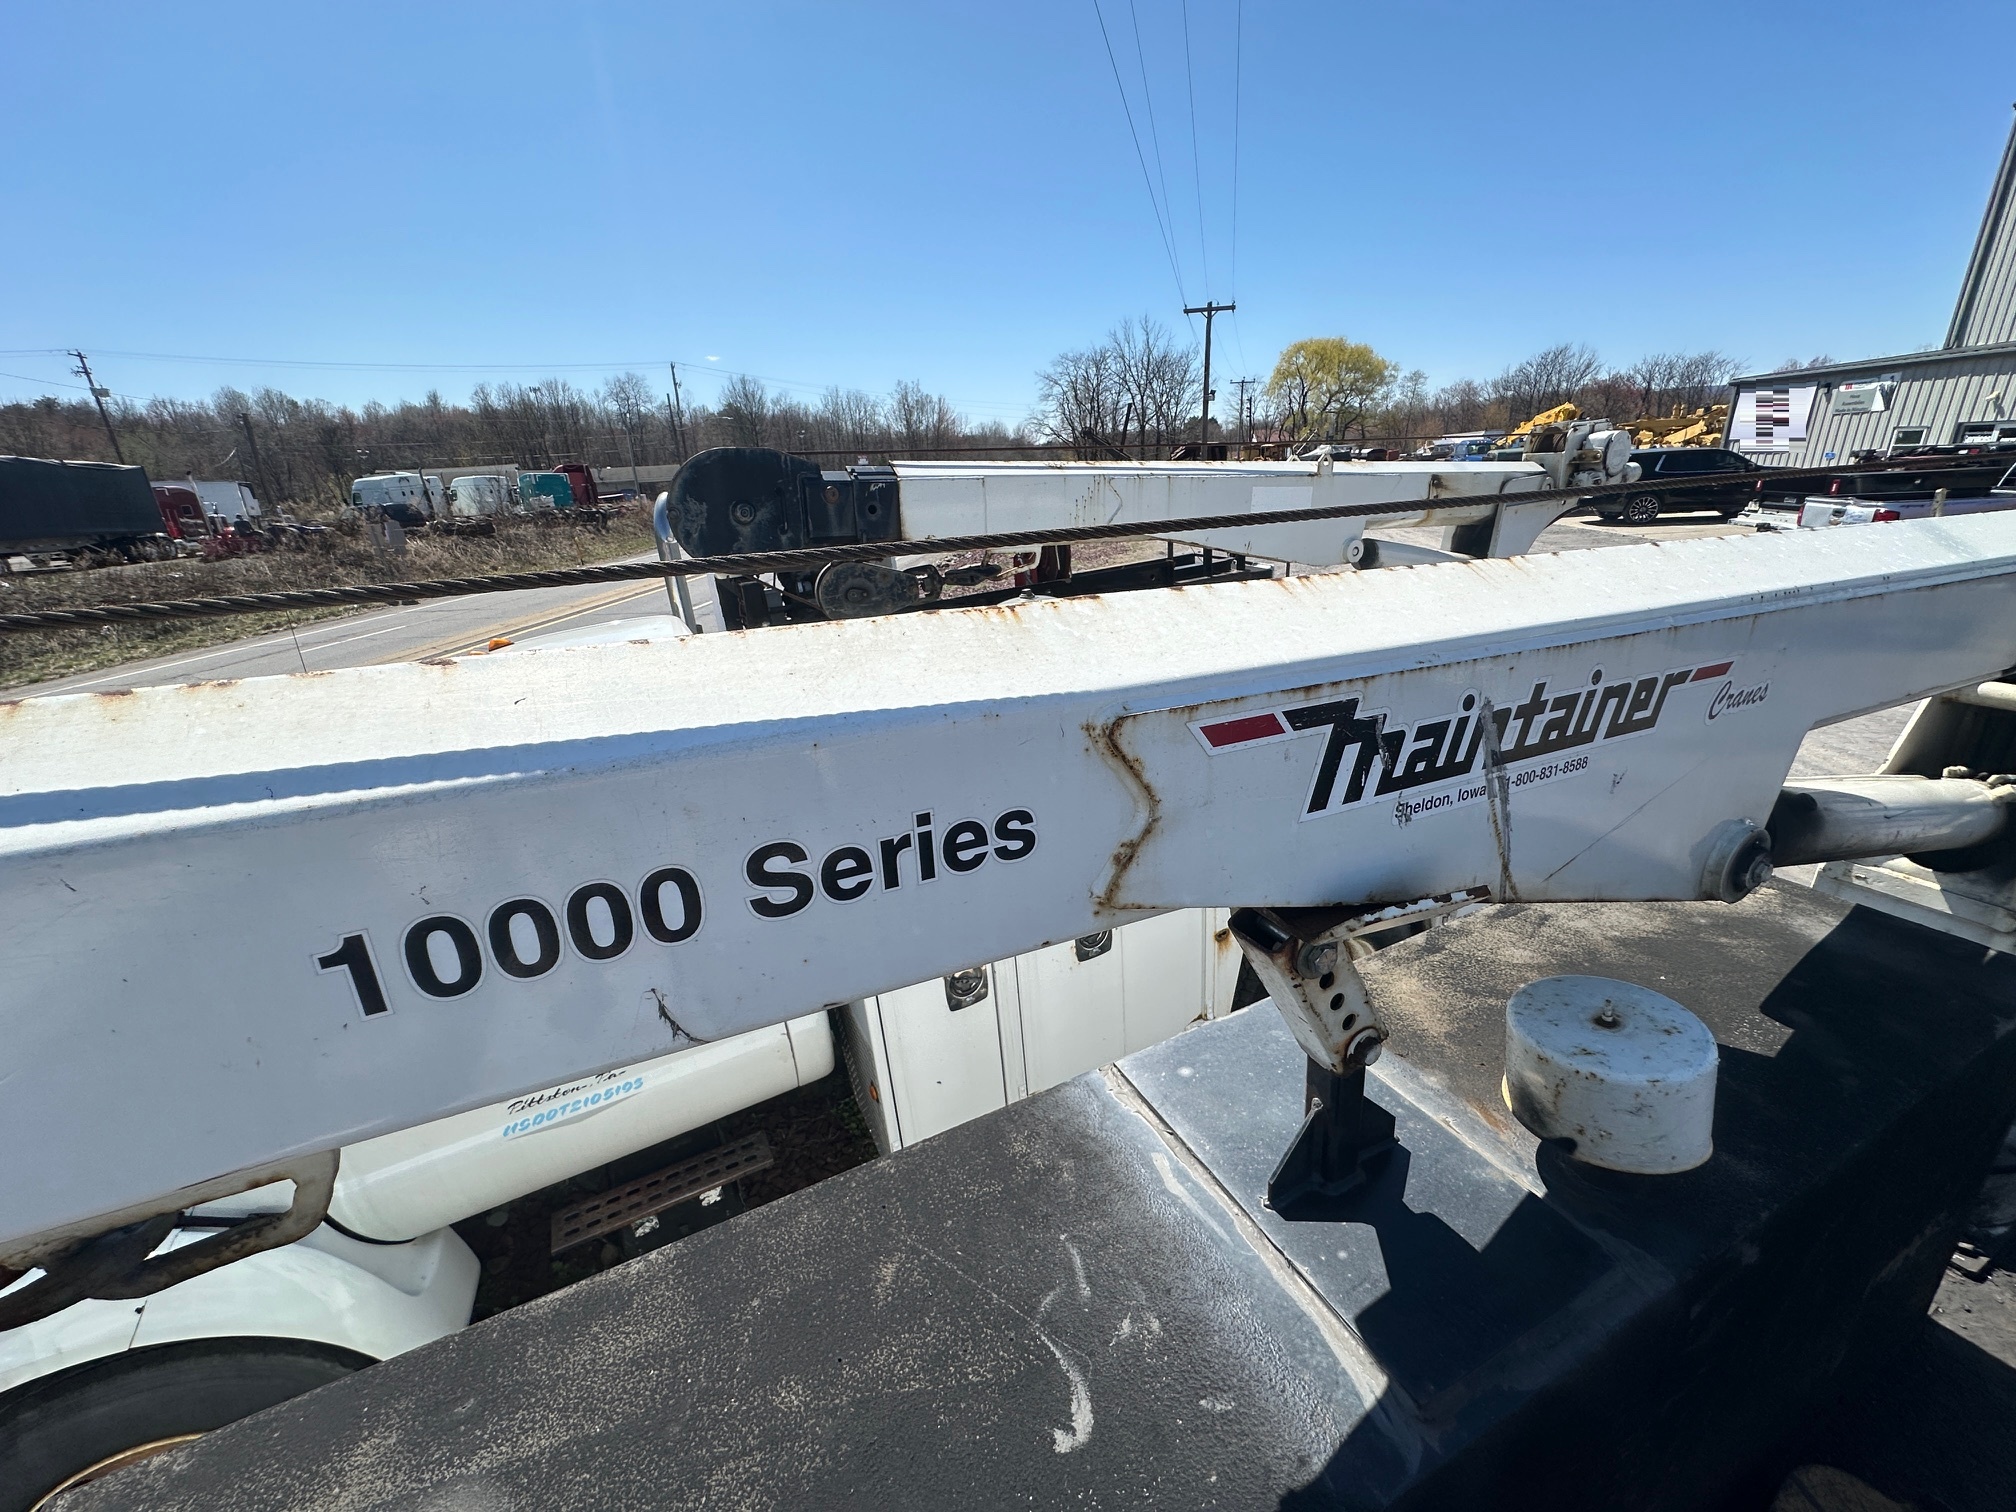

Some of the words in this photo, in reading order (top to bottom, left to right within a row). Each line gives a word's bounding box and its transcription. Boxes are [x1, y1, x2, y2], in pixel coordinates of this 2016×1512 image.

[1708, 680, 1768, 720] Cranes
[1395, 795, 1453, 819] Sheldon,
[1458, 785, 1487, 803] Iowa
[1504, 756, 1589, 790] 1-800-831-8588
[319, 868, 702, 1017] 10000
[745, 808, 1037, 919] Series
